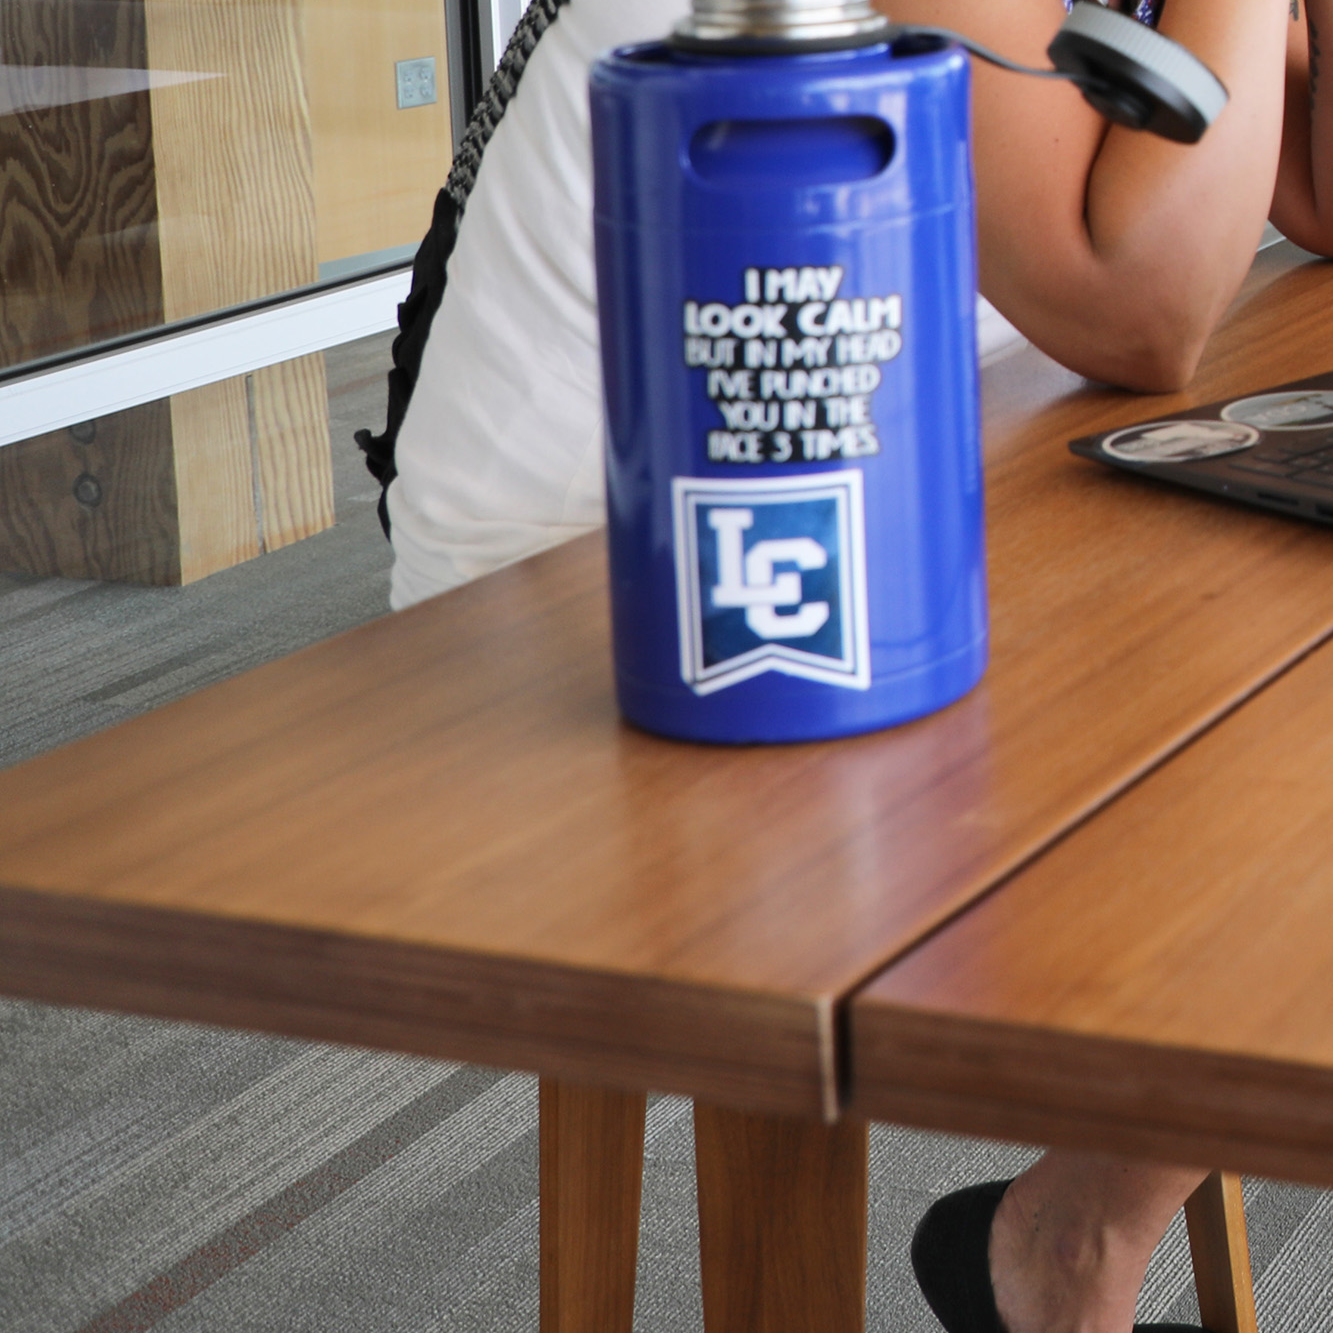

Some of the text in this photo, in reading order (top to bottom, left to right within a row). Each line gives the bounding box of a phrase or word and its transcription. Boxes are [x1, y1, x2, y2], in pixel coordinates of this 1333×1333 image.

[745, 266, 843, 303] I MAY
[684, 295, 902, 338] LOOK CALM
[685, 330, 902, 368] BUT IN MY HEAD
[760, 364, 881, 399] PUNCHED
[718, 395, 870, 431] YOU IN THE
[708, 424, 880, 462] FACE 3 TIMES
[707, 508, 829, 639] LC
